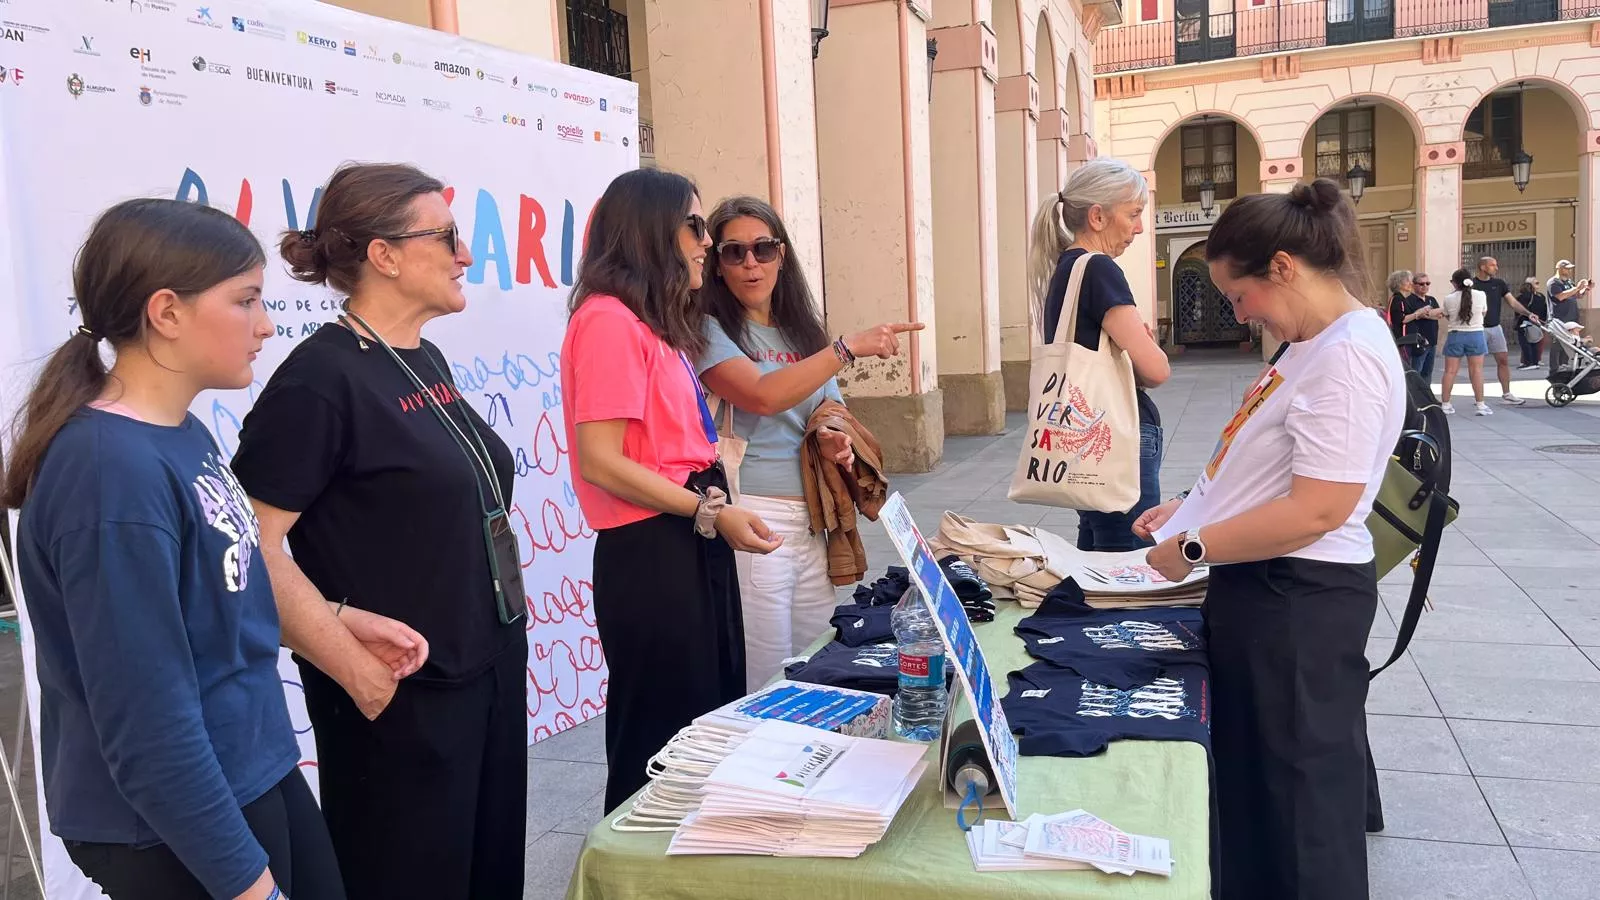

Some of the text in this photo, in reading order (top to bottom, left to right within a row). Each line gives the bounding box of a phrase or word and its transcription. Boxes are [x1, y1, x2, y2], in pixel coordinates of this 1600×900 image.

[308, 35, 337, 49] XERYO
[434, 60, 471, 77] amazon
[246, 66, 313, 91] BUENAVENTURA
[375, 92, 406, 103] NOMADA
[563, 91, 589, 104] avanza
[1464, 219, 1528, 235] EJIDOS
[296, 299, 312, 312] DE
[276, 324, 294, 338] DE
[1042, 372, 1067, 398] DI
[1036, 402, 1073, 426] VER
[1030, 428, 1052, 452] SA
[1026, 456, 1068, 484] RIO
[1076, 681, 1119, 717] DIVE
